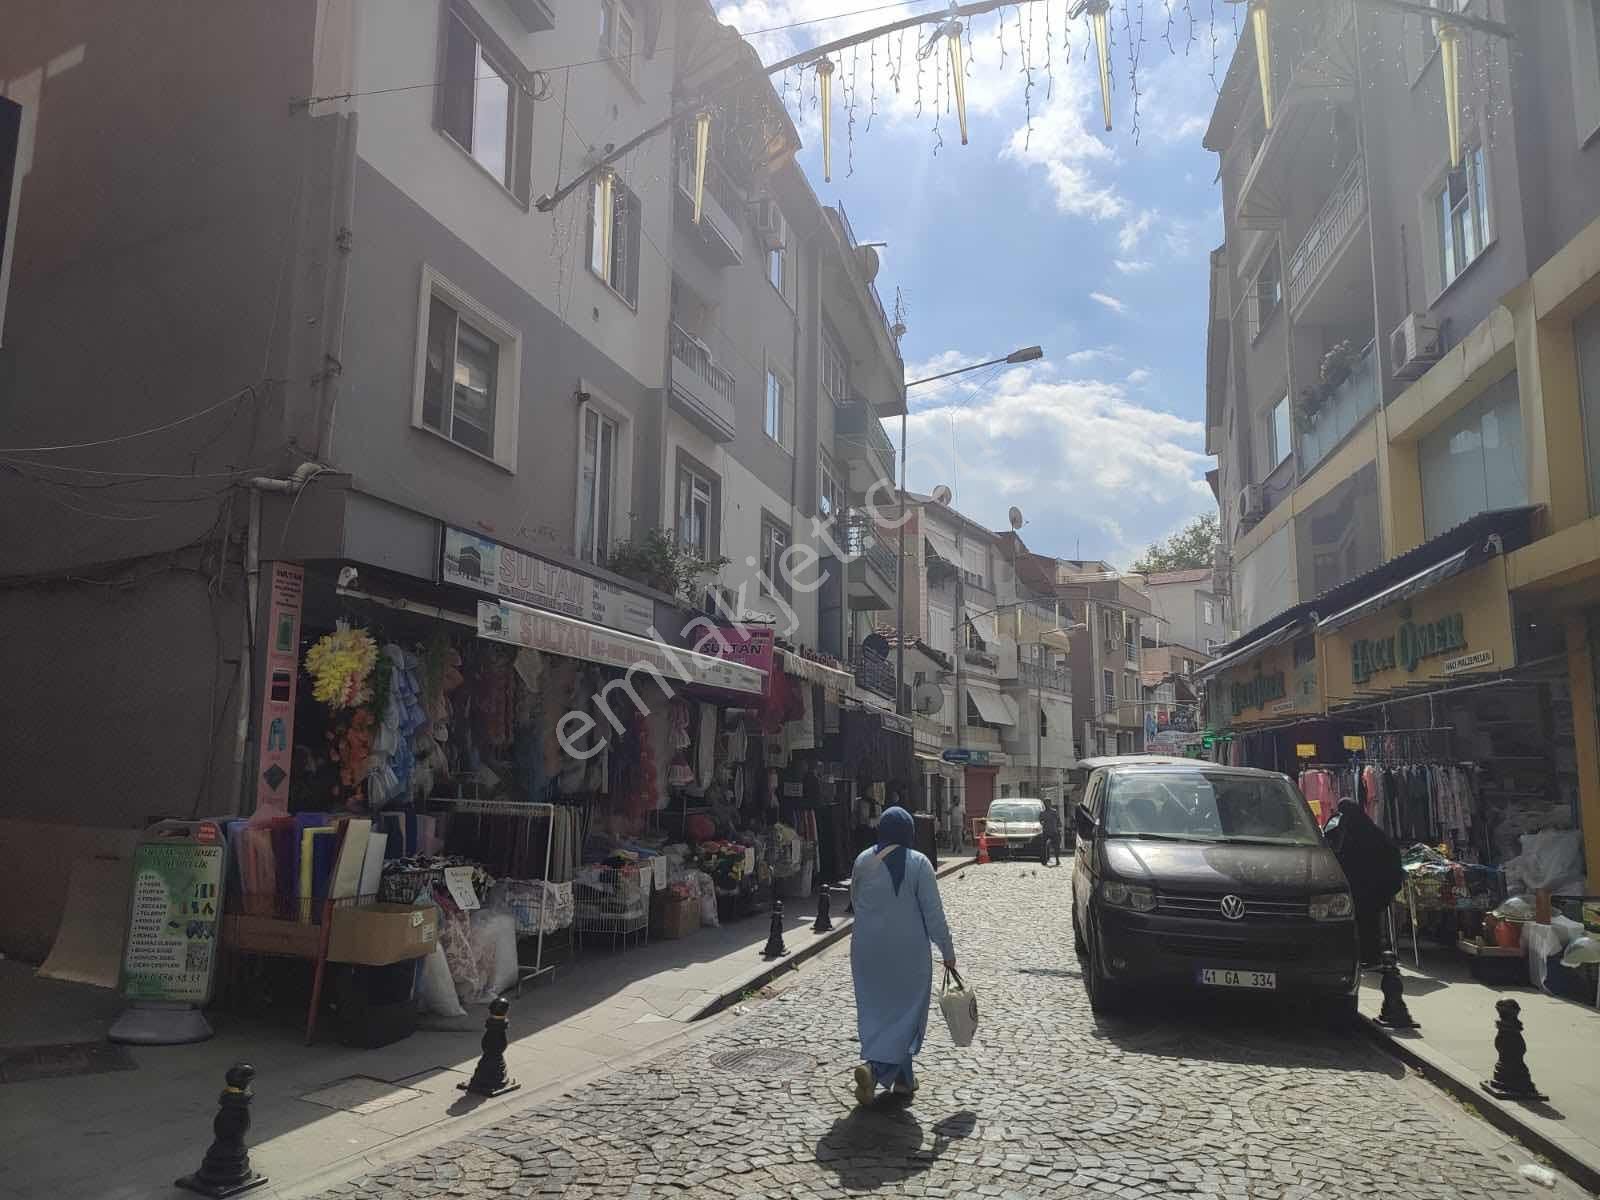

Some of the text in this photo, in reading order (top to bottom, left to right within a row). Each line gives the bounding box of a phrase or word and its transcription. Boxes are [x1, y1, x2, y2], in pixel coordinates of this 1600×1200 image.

[500, 548, 585, 604] SULTAN
[519, 610, 592, 656] SULTAN
[703, 643, 762, 654] SULTAN
[1204, 970, 1272, 987] 41 GA 334
